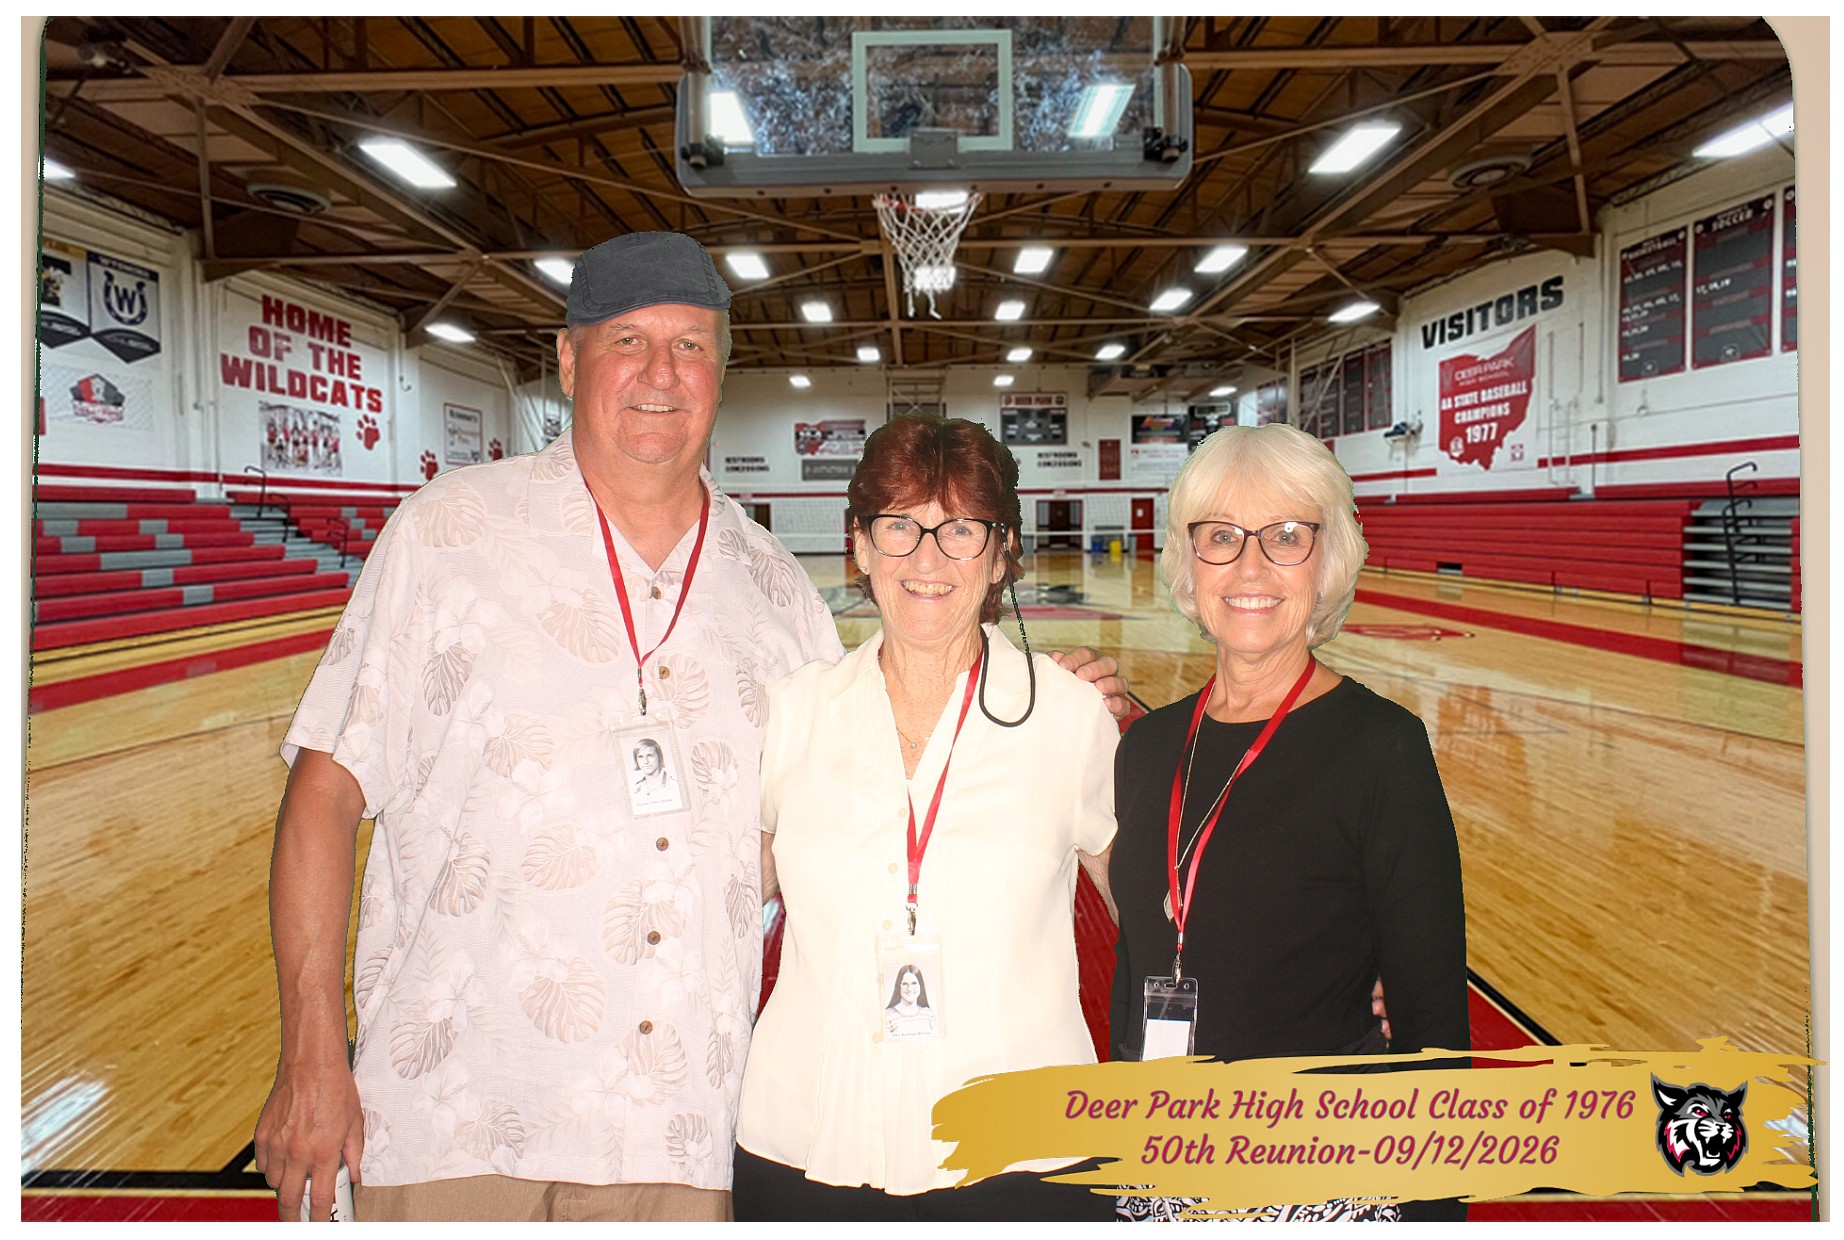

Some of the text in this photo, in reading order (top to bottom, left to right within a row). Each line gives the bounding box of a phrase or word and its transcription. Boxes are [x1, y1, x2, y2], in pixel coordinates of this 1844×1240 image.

[113, 283, 136, 315] W
[1421, 275, 1564, 349] VISITORS
[262, 294, 352, 348] HOME
[248, 325, 362, 380] OF THE
[1454, 356, 1514, 381] DEER PARK
[220, 352, 383, 413] WILDCATS
[1441, 380, 1527, 411] AA STATE BASEBALL
[1454, 402, 1510, 424] CHAMPIONS
[1465, 422, 1498, 444] 1977
